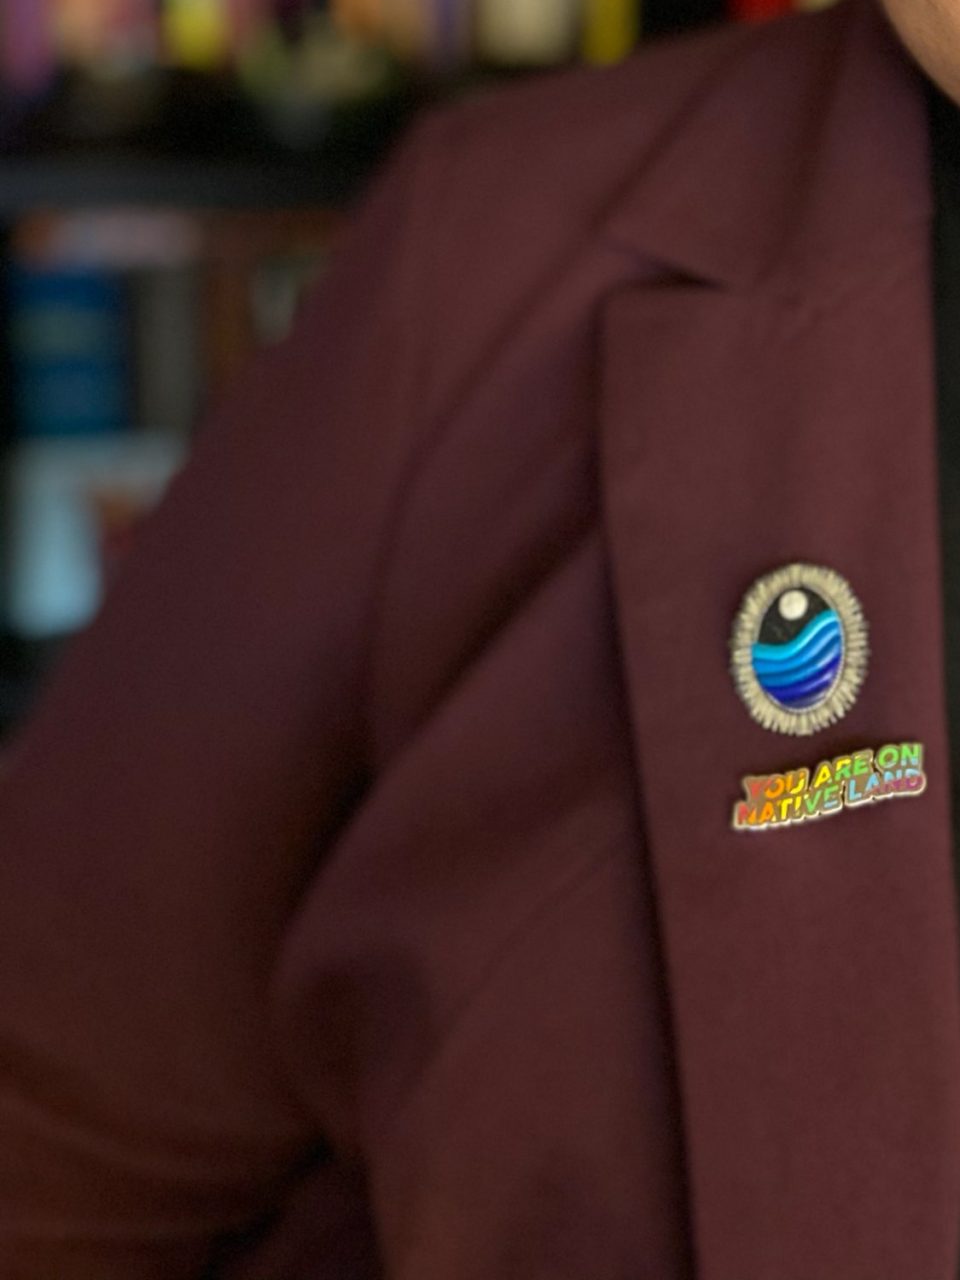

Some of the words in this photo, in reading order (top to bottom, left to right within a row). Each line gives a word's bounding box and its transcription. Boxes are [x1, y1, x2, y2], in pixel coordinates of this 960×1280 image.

[737, 784, 839, 825] NATIVE
[848, 768, 923, 801] LAND
[747, 770, 806, 798] YOU
[814, 755, 870, 788] ARE
[878, 743, 921, 768] ON
